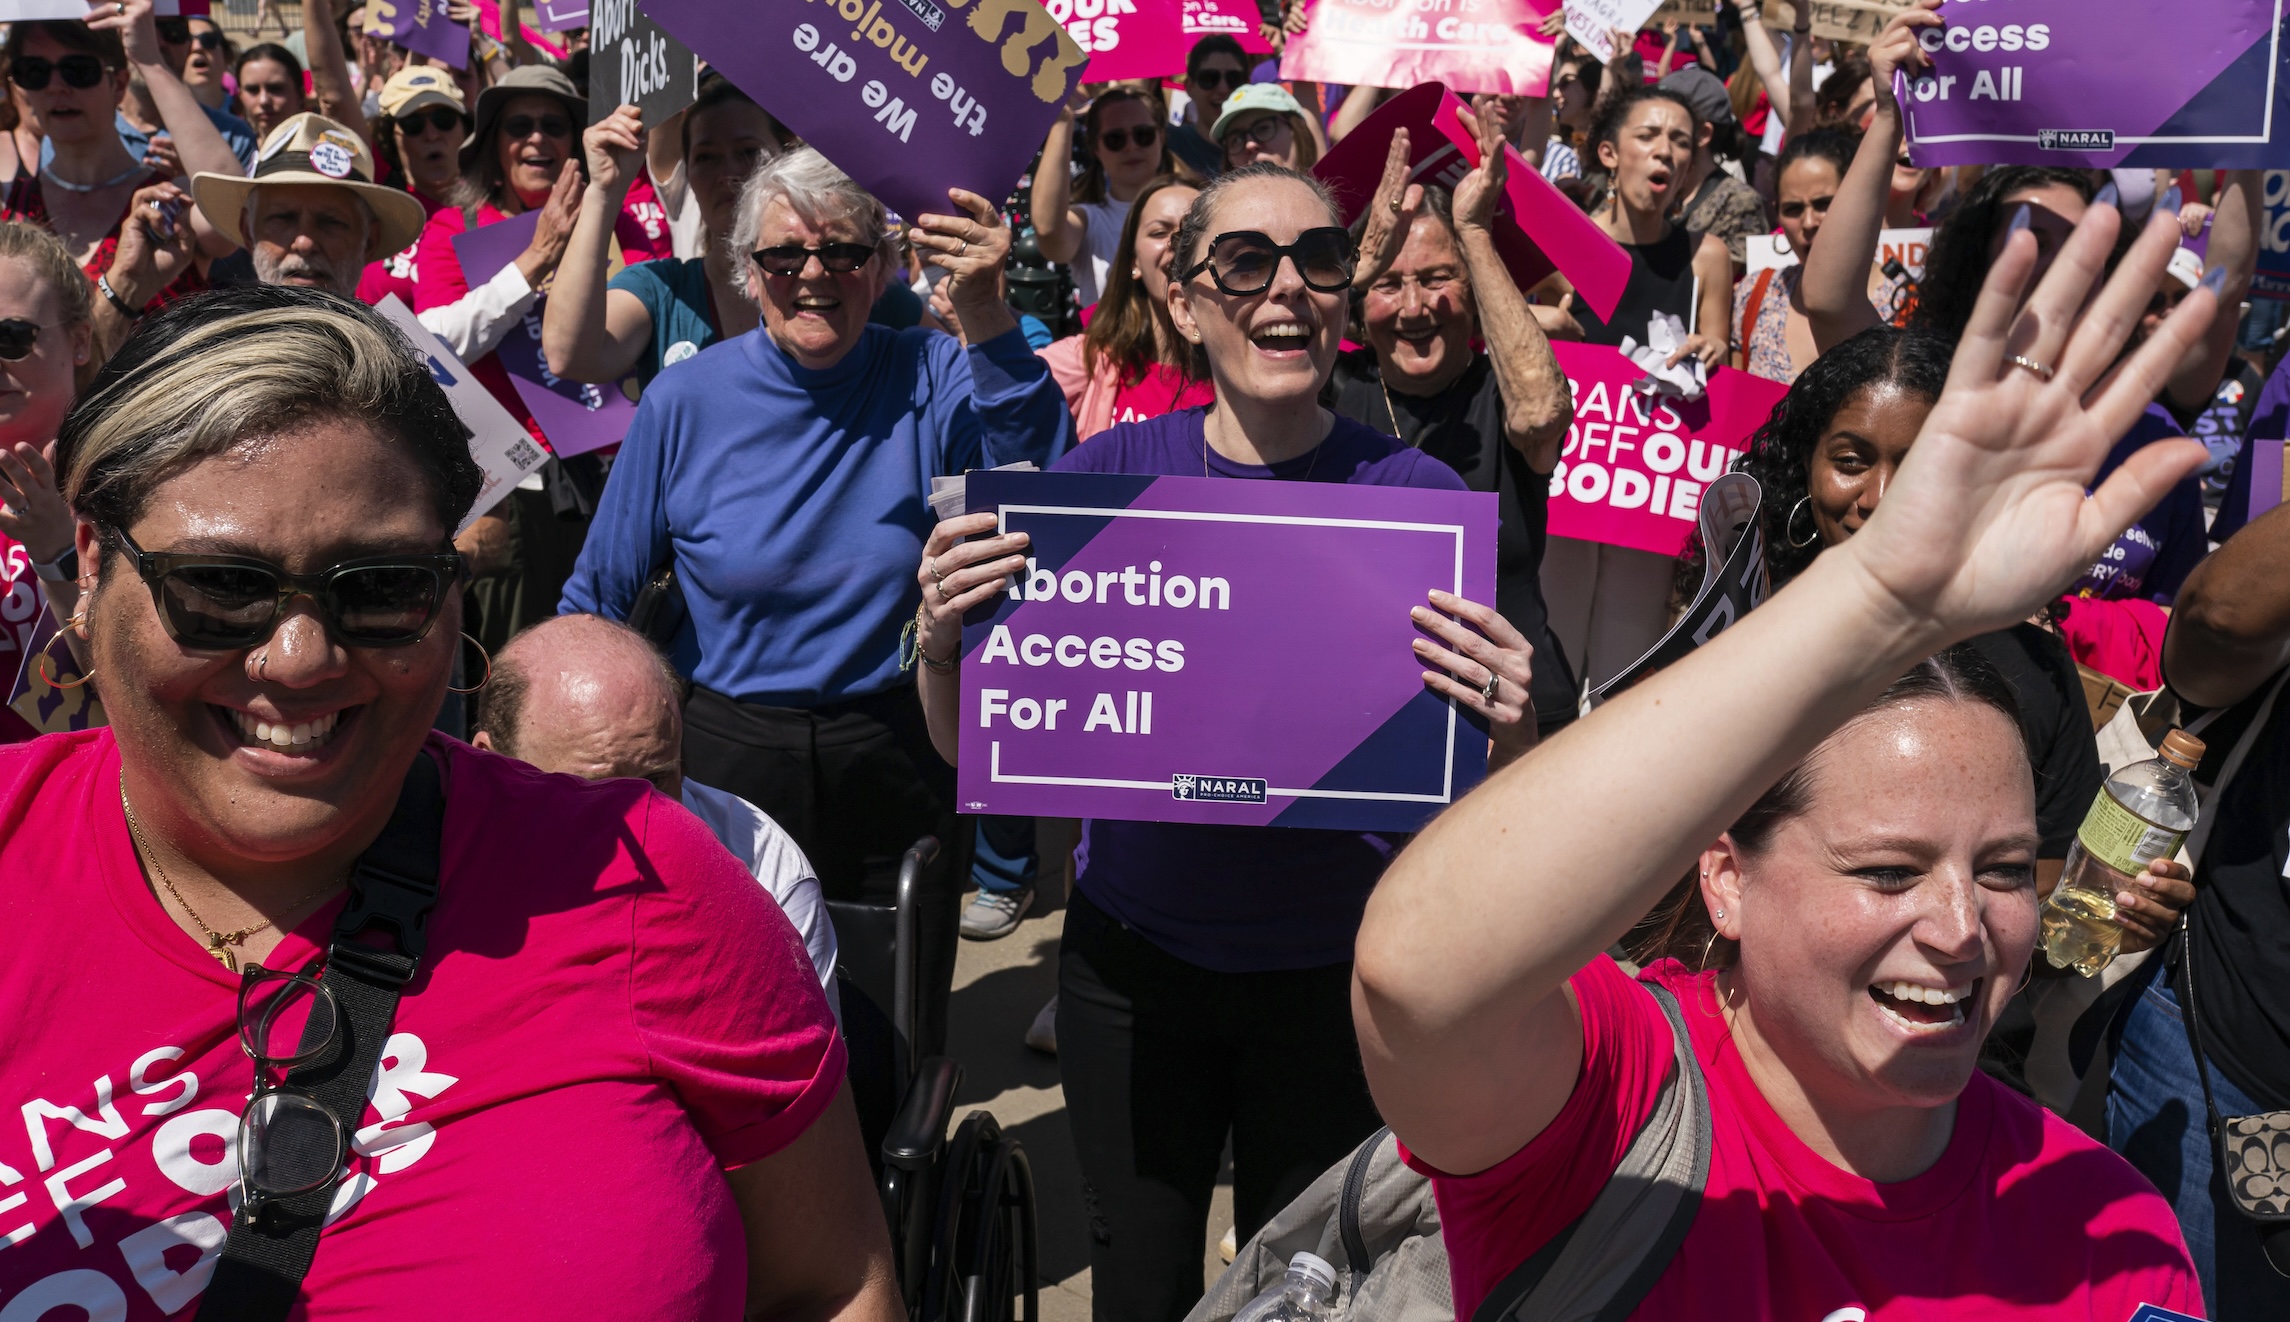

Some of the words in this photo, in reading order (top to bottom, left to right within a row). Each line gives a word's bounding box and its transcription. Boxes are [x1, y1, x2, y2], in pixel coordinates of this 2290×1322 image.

[804, 0, 930, 78] majo
[1199, 13, 1247, 28] Care.
[1918, 23, 2050, 52] ccess
[620, 30, 671, 107] Dicks.
[792, 22, 857, 83] are
[930, 71, 988, 137] the
[1969, 66, 2023, 101] All
[861, 79, 918, 144] We
[2059, 132, 2110, 144] NARAL
[1549, 459, 1702, 523] BODIE
[980, 624, 1185, 673] Access
[979, 688, 1067, 731] For
[1082, 690, 1153, 735] All
[1200, 779, 1261, 795] NARAL
